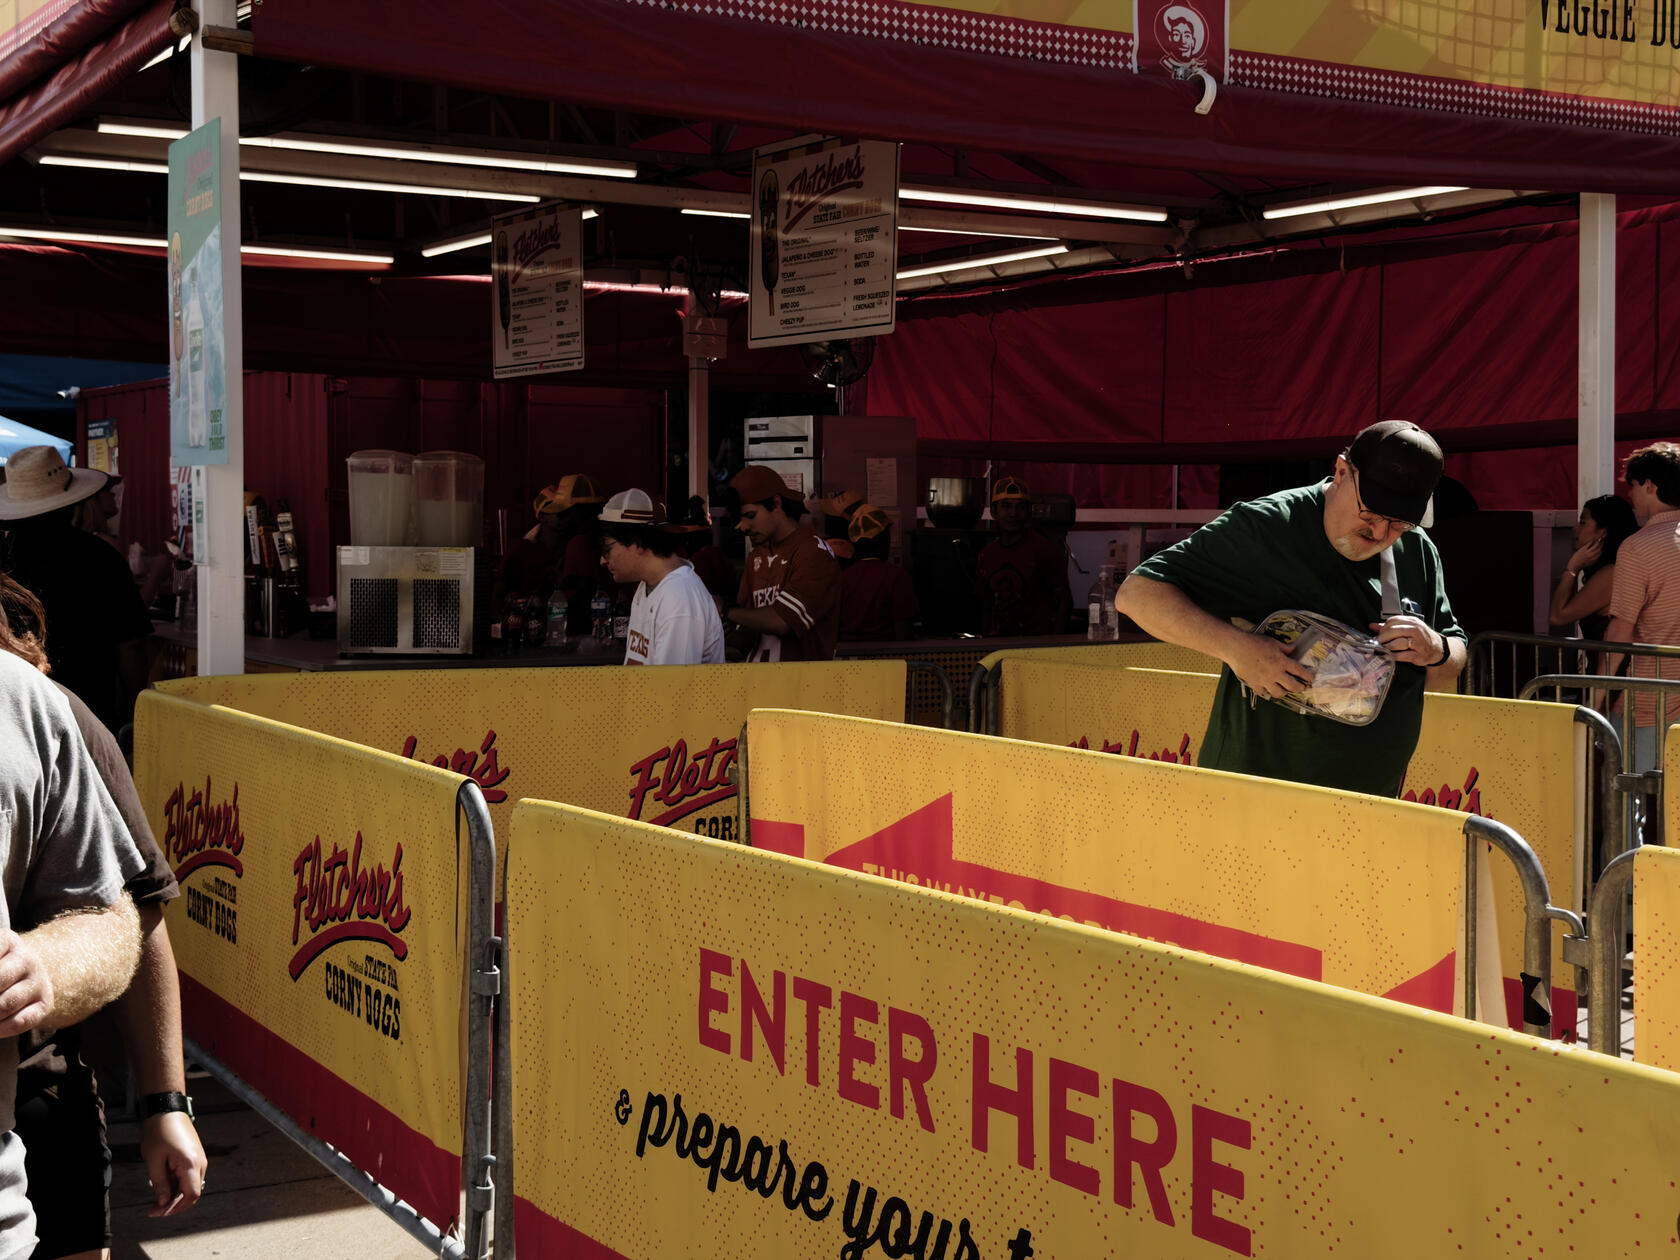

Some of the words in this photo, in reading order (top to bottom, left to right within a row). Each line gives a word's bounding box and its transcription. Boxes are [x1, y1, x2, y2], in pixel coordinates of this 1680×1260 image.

[786, 145, 865, 219] Fletcher's
[813, 212, 829, 224] STATE
[829, 210, 842, 222] FAIR
[165, 775, 244, 868] Fletcher's
[187, 886, 214, 931] CORNY
[215, 901, 238, 945] DOGS
[293, 830, 411, 946] Fletcher's
[325, 961, 363, 1018] CORNY
[364, 984, 401, 1041] DOGS
[347, 954, 364, 976] Original
[364, 954, 388, 985] STATE
[699, 947, 938, 1134] ENTER
[615, 1088, 633, 1126] &
[636, 1091, 835, 1222] prepare
[971, 1031, 1252, 1258] HERE
